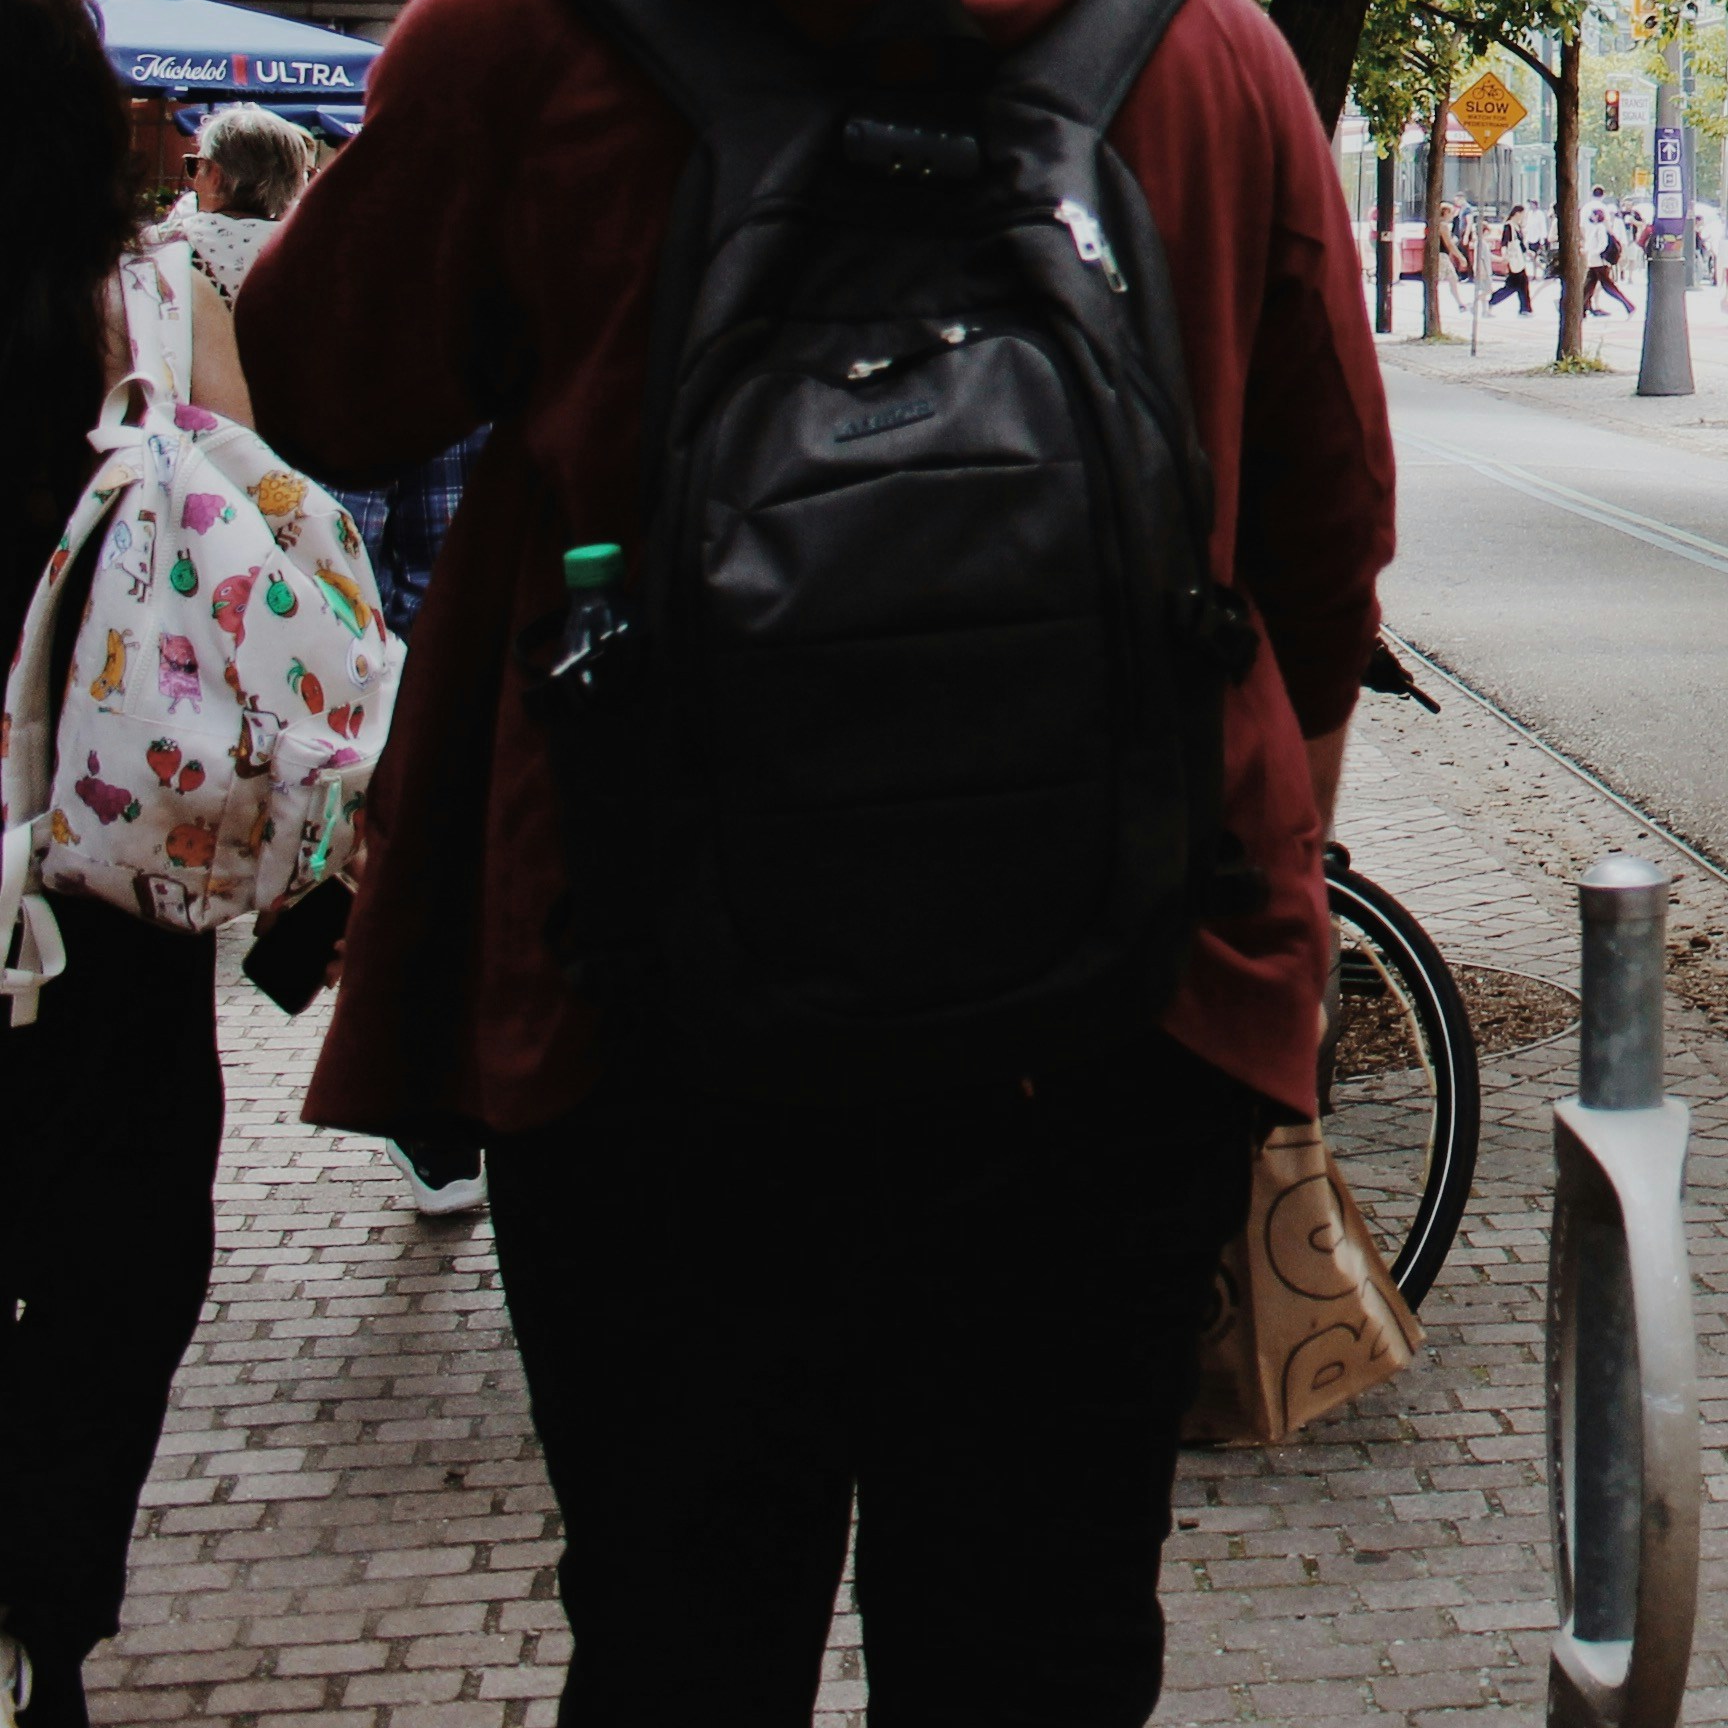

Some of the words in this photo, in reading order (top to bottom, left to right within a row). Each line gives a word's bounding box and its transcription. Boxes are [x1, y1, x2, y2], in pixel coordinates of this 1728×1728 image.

[132, 53, 226, 82] Michelob
[1466, 101, 1509, 113] SLOW
[1621, 97, 1648, 109] TRANSIT
[1622, 111, 1647, 121] SIGNAL
